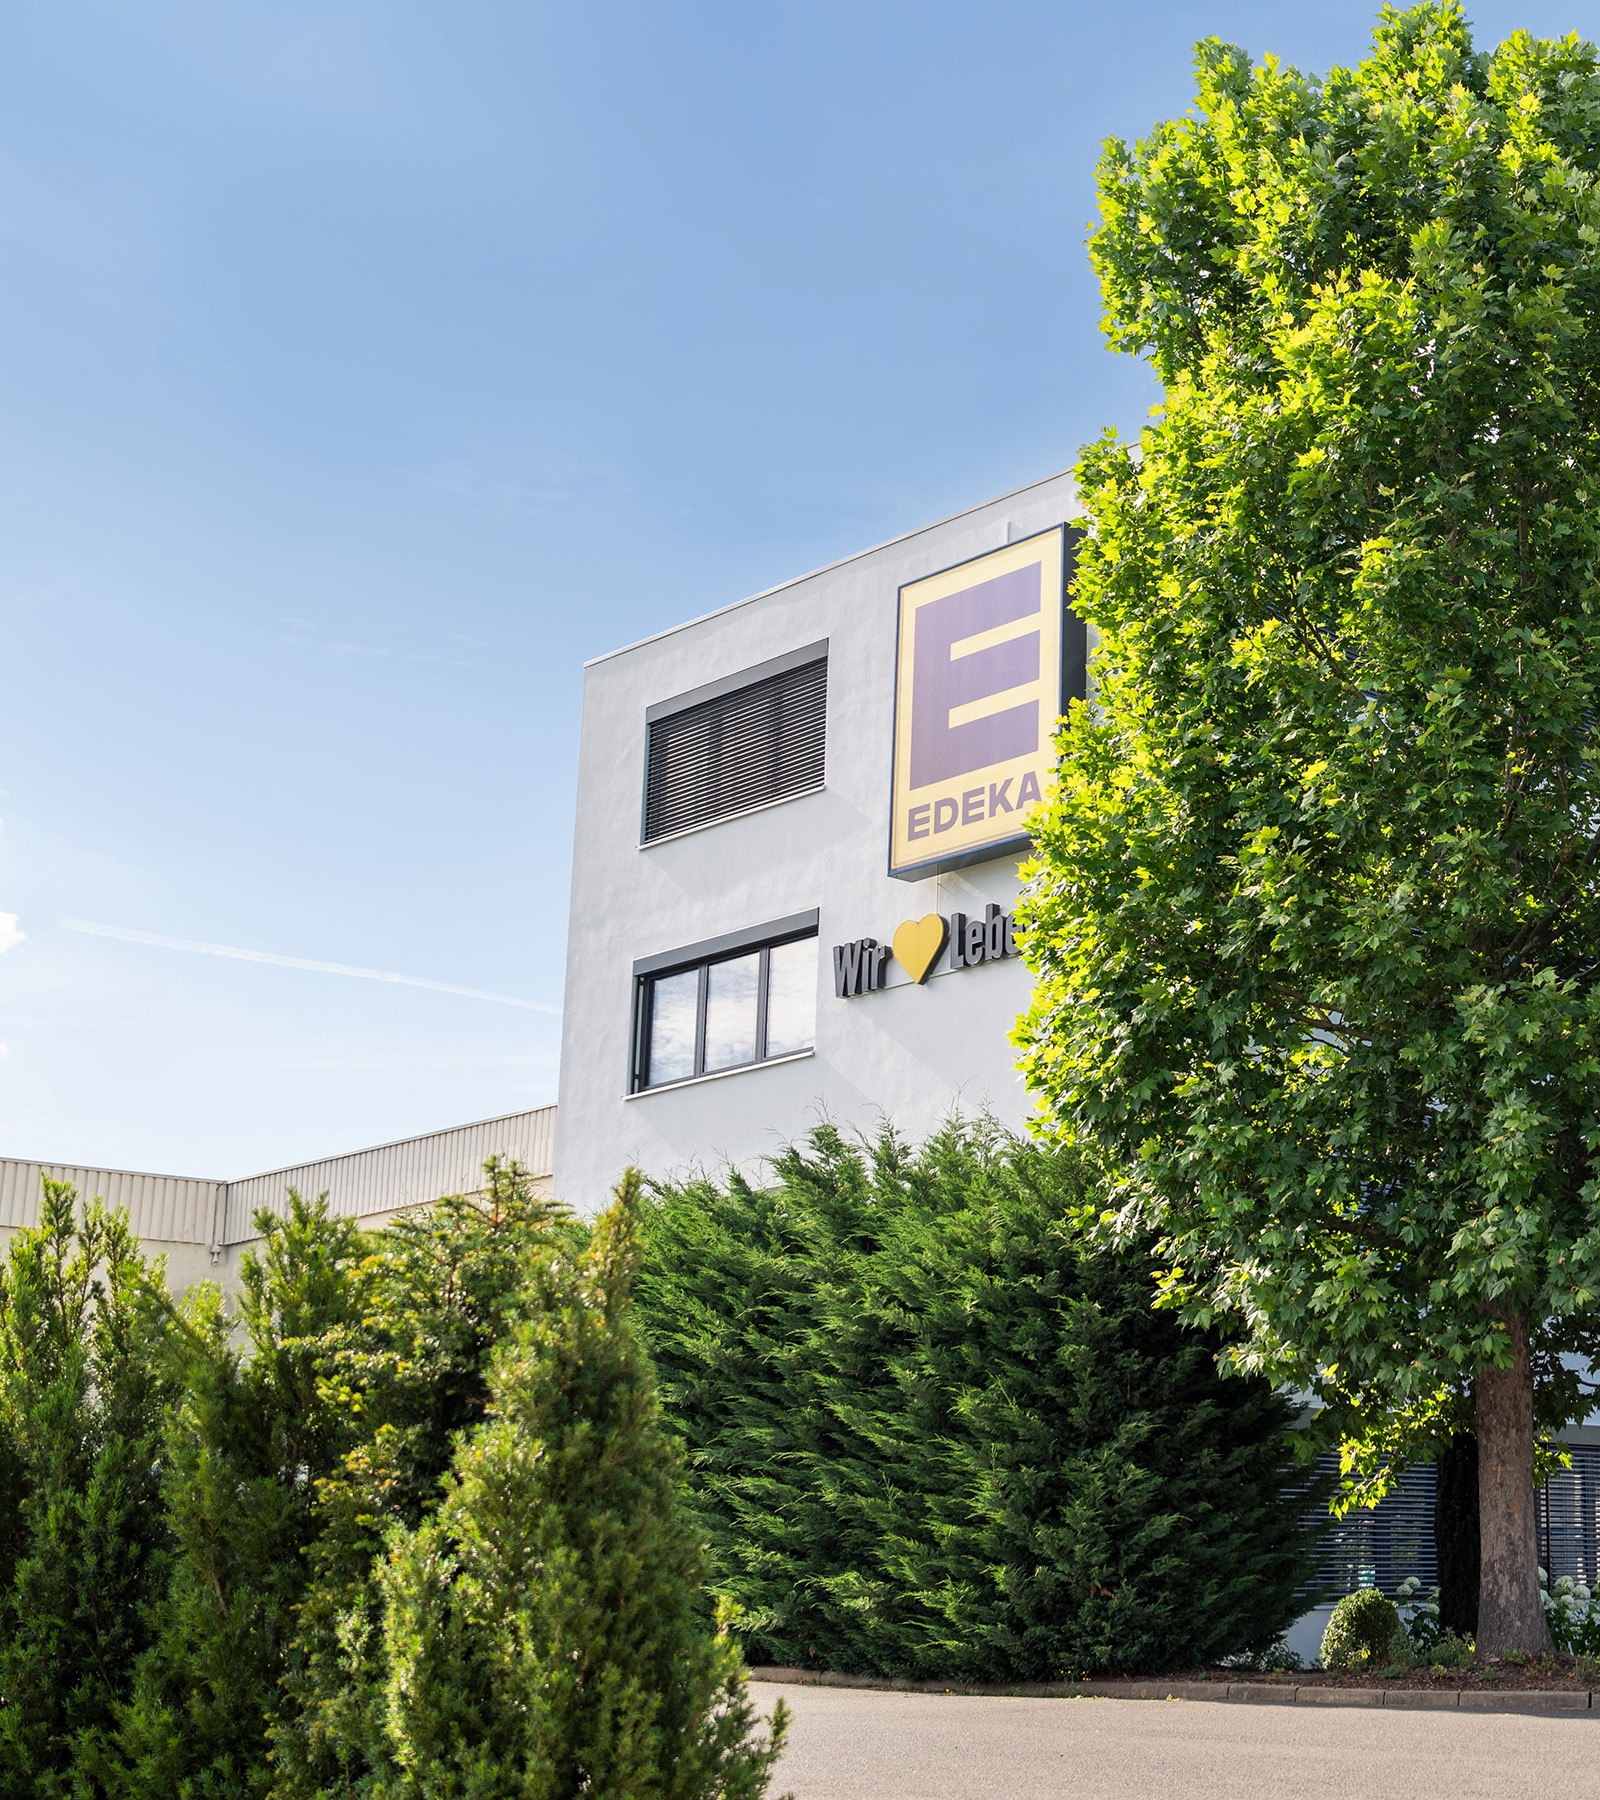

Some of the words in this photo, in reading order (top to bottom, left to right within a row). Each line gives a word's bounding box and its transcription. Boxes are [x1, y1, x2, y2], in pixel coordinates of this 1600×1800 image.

[909, 560, 1042, 791] E
[907, 770, 1042, 842] EDEKA
[833, 938, 893, 999] Wir
[950, 903, 1033, 969] Lebe
